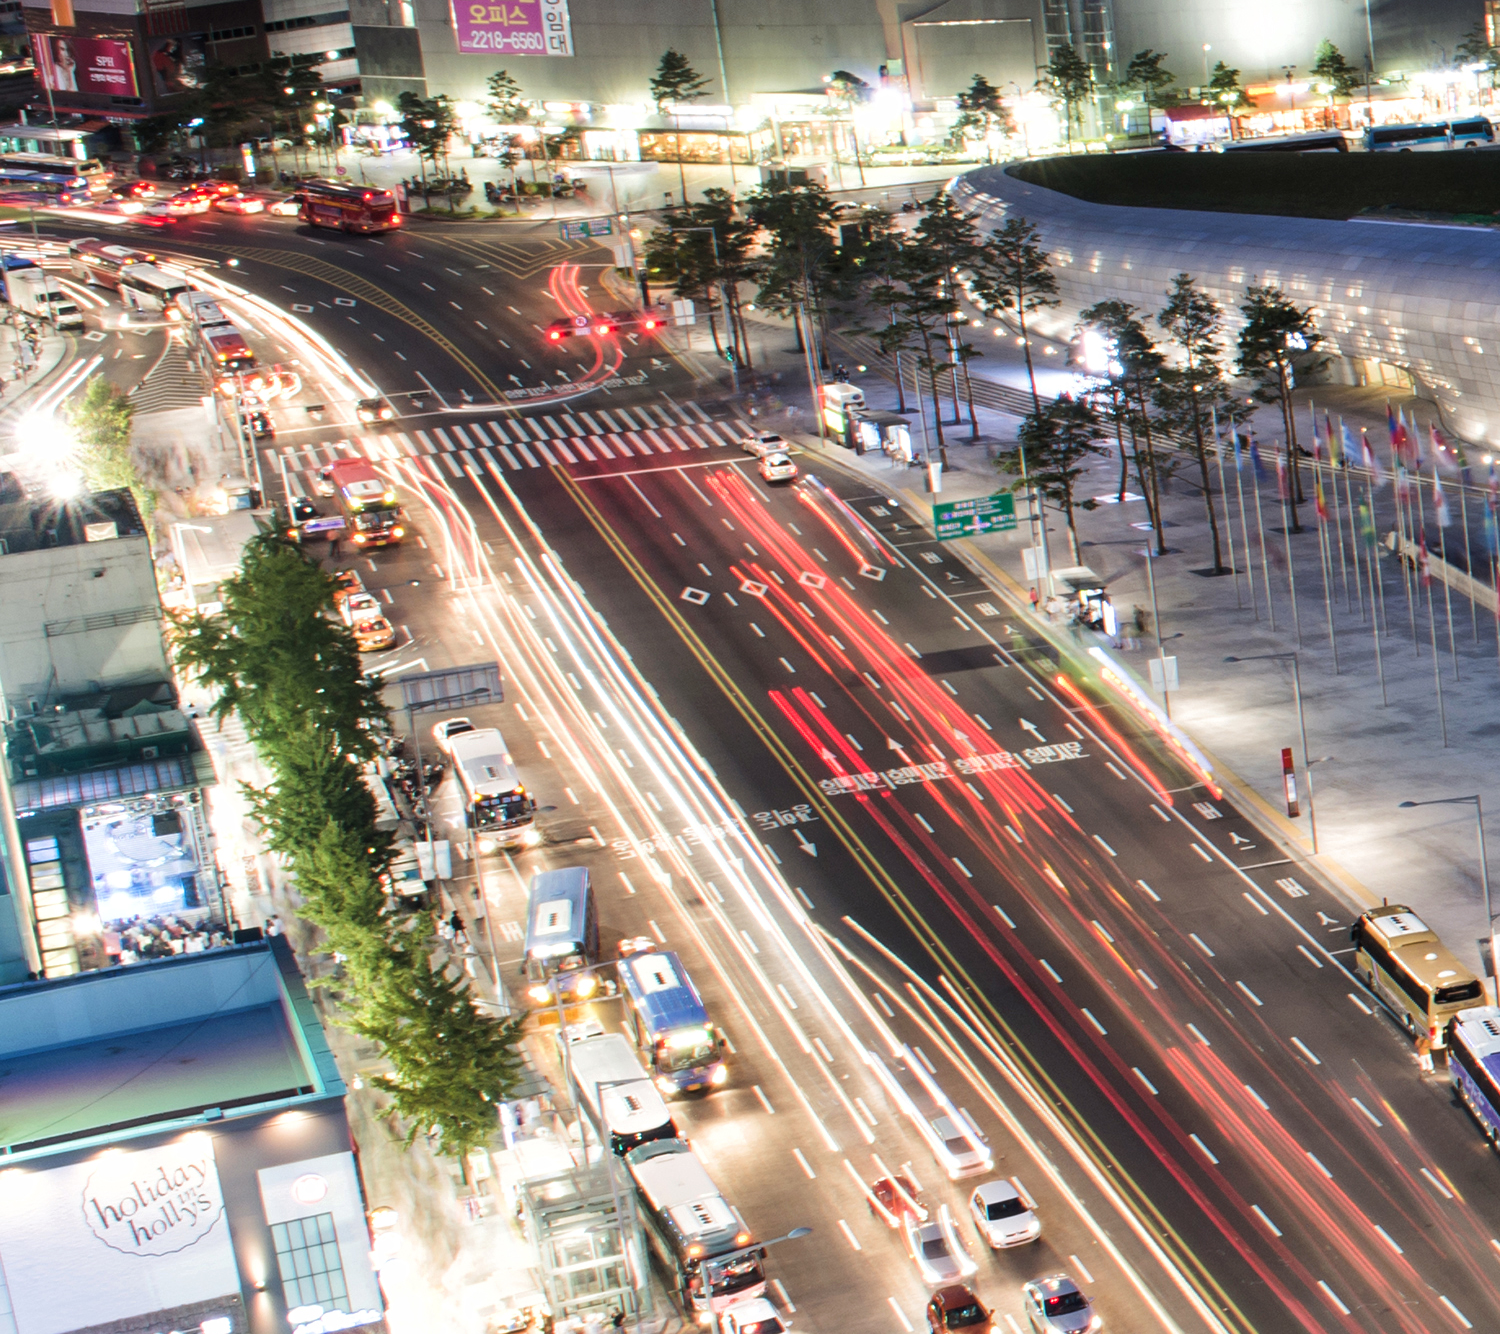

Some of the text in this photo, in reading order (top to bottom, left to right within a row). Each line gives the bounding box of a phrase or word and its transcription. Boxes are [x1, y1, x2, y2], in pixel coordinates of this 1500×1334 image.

[469, 4, 529, 26] 오피스
[471, 30, 544, 50] 2218-6560
[90, 1159, 207, 1230] holiday
[176, 1188, 197, 1204] in
[127, 1193, 213, 1247] hollys
